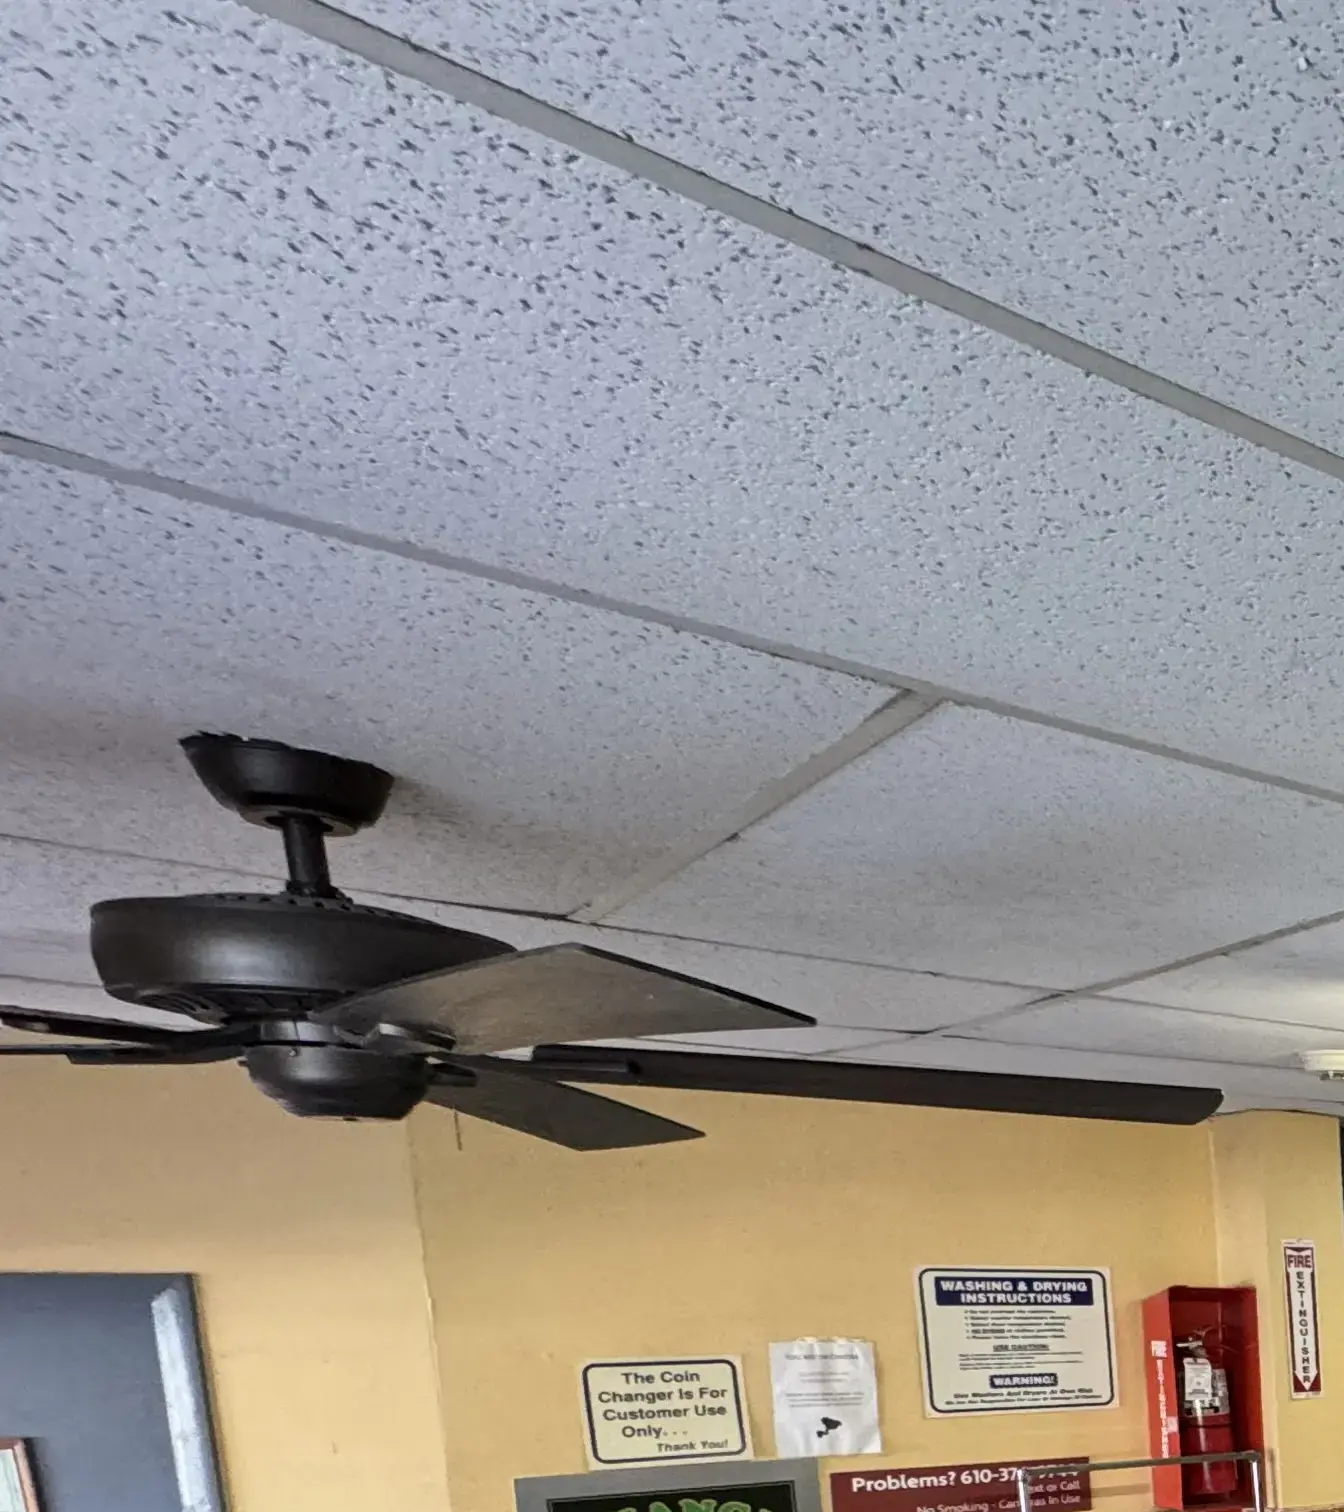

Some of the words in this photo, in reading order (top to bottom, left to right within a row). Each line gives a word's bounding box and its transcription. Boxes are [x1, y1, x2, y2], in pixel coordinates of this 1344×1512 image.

[1287, 1255, 1312, 1268] FIRE
[940, 1280, 1013, 1292] WASHING
[1017, 1281, 1028, 1292] &
[1033, 1281, 1087, 1292] DRYING
[960, 1292, 1072, 1304] INSTRUCTIONS
[1296, 1271, 1311, 1383] EXTINGUISHER
[621, 1372, 655, 1384] The
[660, 1370, 700, 1383] Coin
[993, 1376, 1054, 1387] WARNING!
[598, 1388, 674, 1404] Changer
[679, 1388, 694, 1400] Is
[700, 1387, 727, 1399] For
[603, 1406, 690, 1421] Customer
[694, 1405, 727, 1417] Use
[657, 1441, 696, 1453] Thank
[700, 1439, 729, 1450] You!
[852, 1472, 956, 1492] Problems?
[960, 1464, 1079, 1485] 610-37
